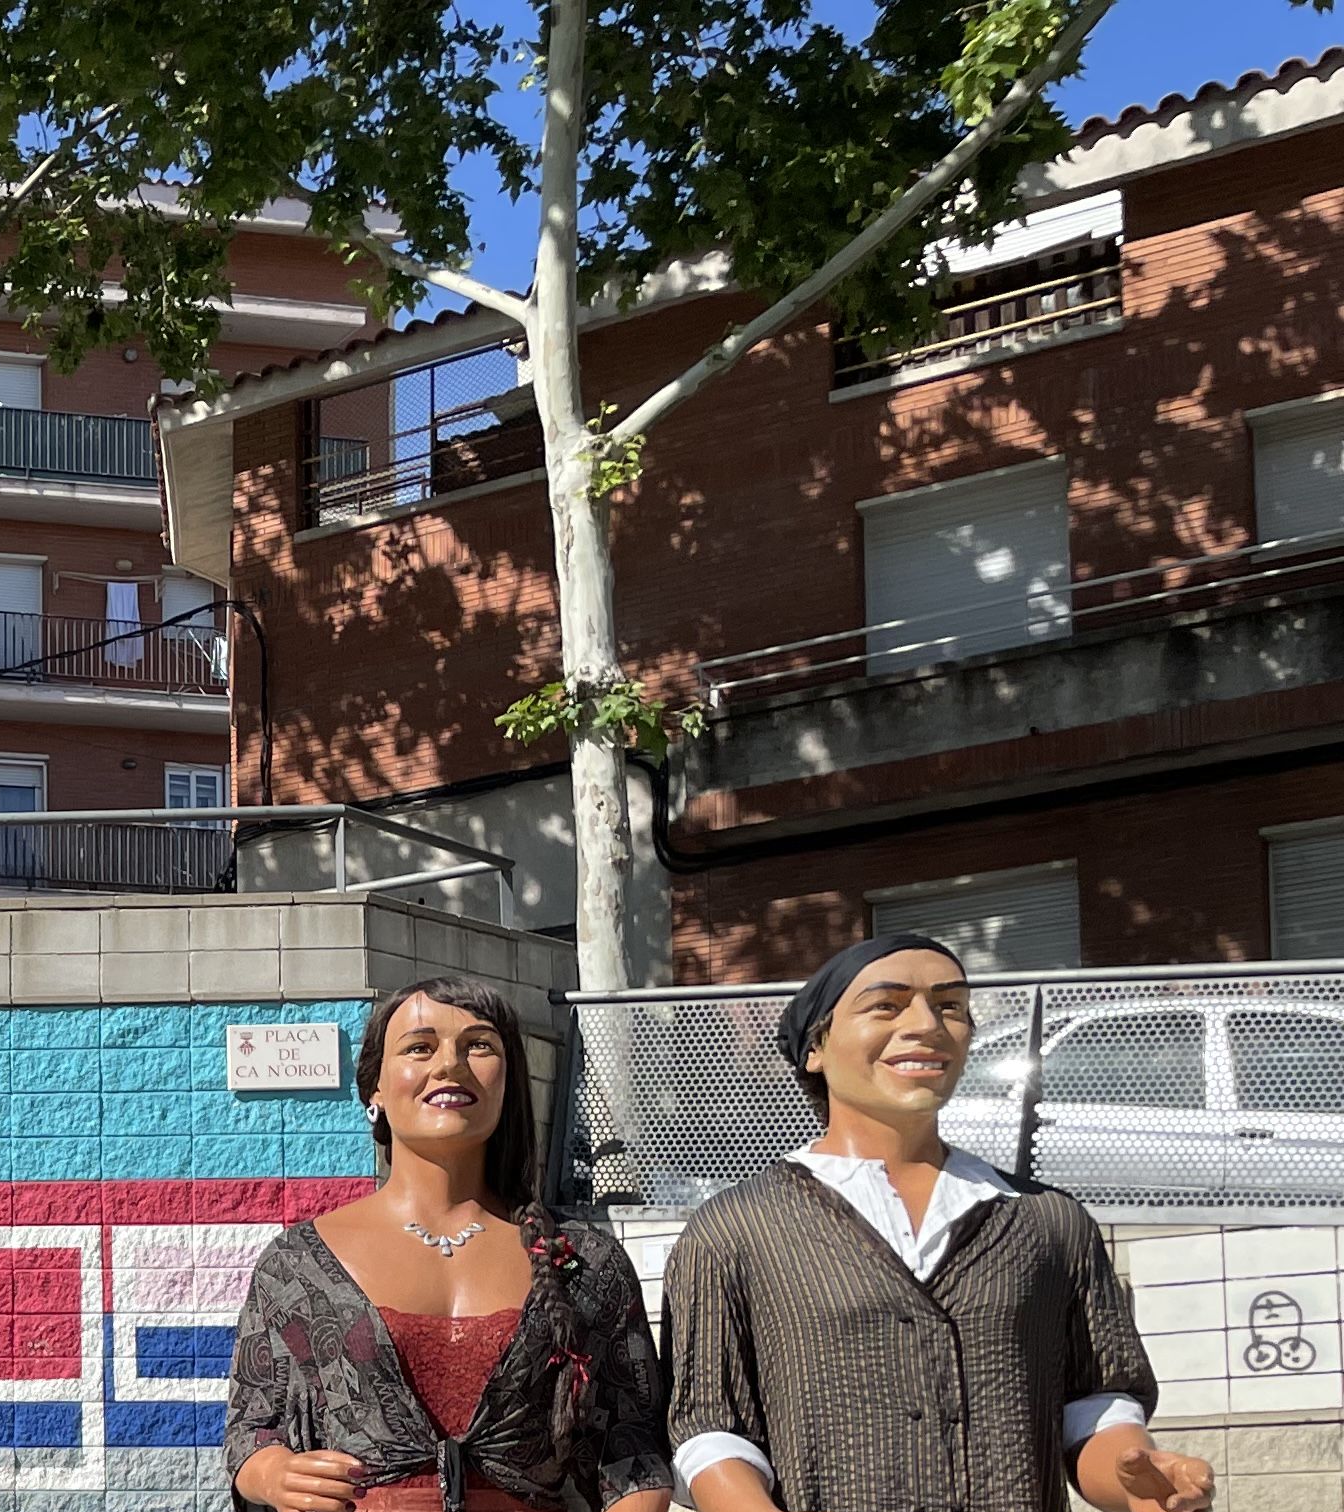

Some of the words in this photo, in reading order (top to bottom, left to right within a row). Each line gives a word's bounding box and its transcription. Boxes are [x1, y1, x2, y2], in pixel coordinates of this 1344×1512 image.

[265, 1029, 320, 1044] PLAÇA
[279, 1049, 300, 1060] DE
[236, 1065, 259, 1078] CA
